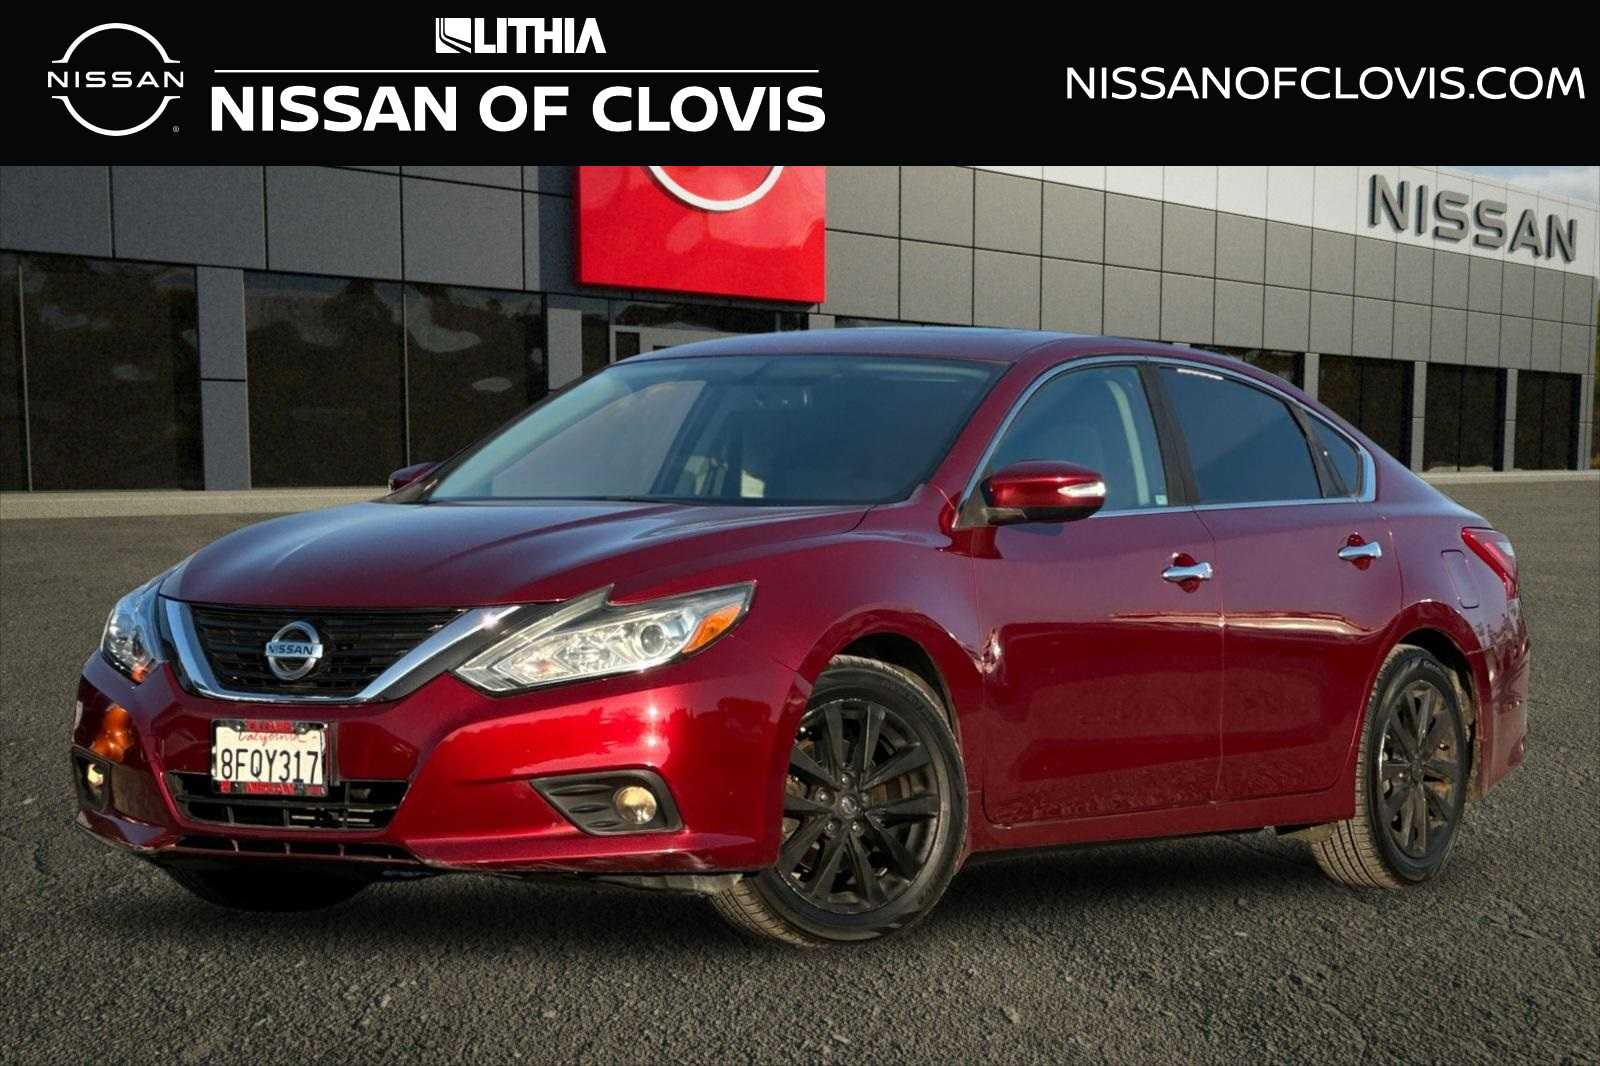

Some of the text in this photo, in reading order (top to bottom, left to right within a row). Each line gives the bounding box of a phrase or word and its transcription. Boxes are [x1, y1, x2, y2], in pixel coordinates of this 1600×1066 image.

[1368, 174, 1578, 262] NISSAN
[267, 643, 314, 655] NISSAN
[221, 748, 319, 784] 8FQY317
